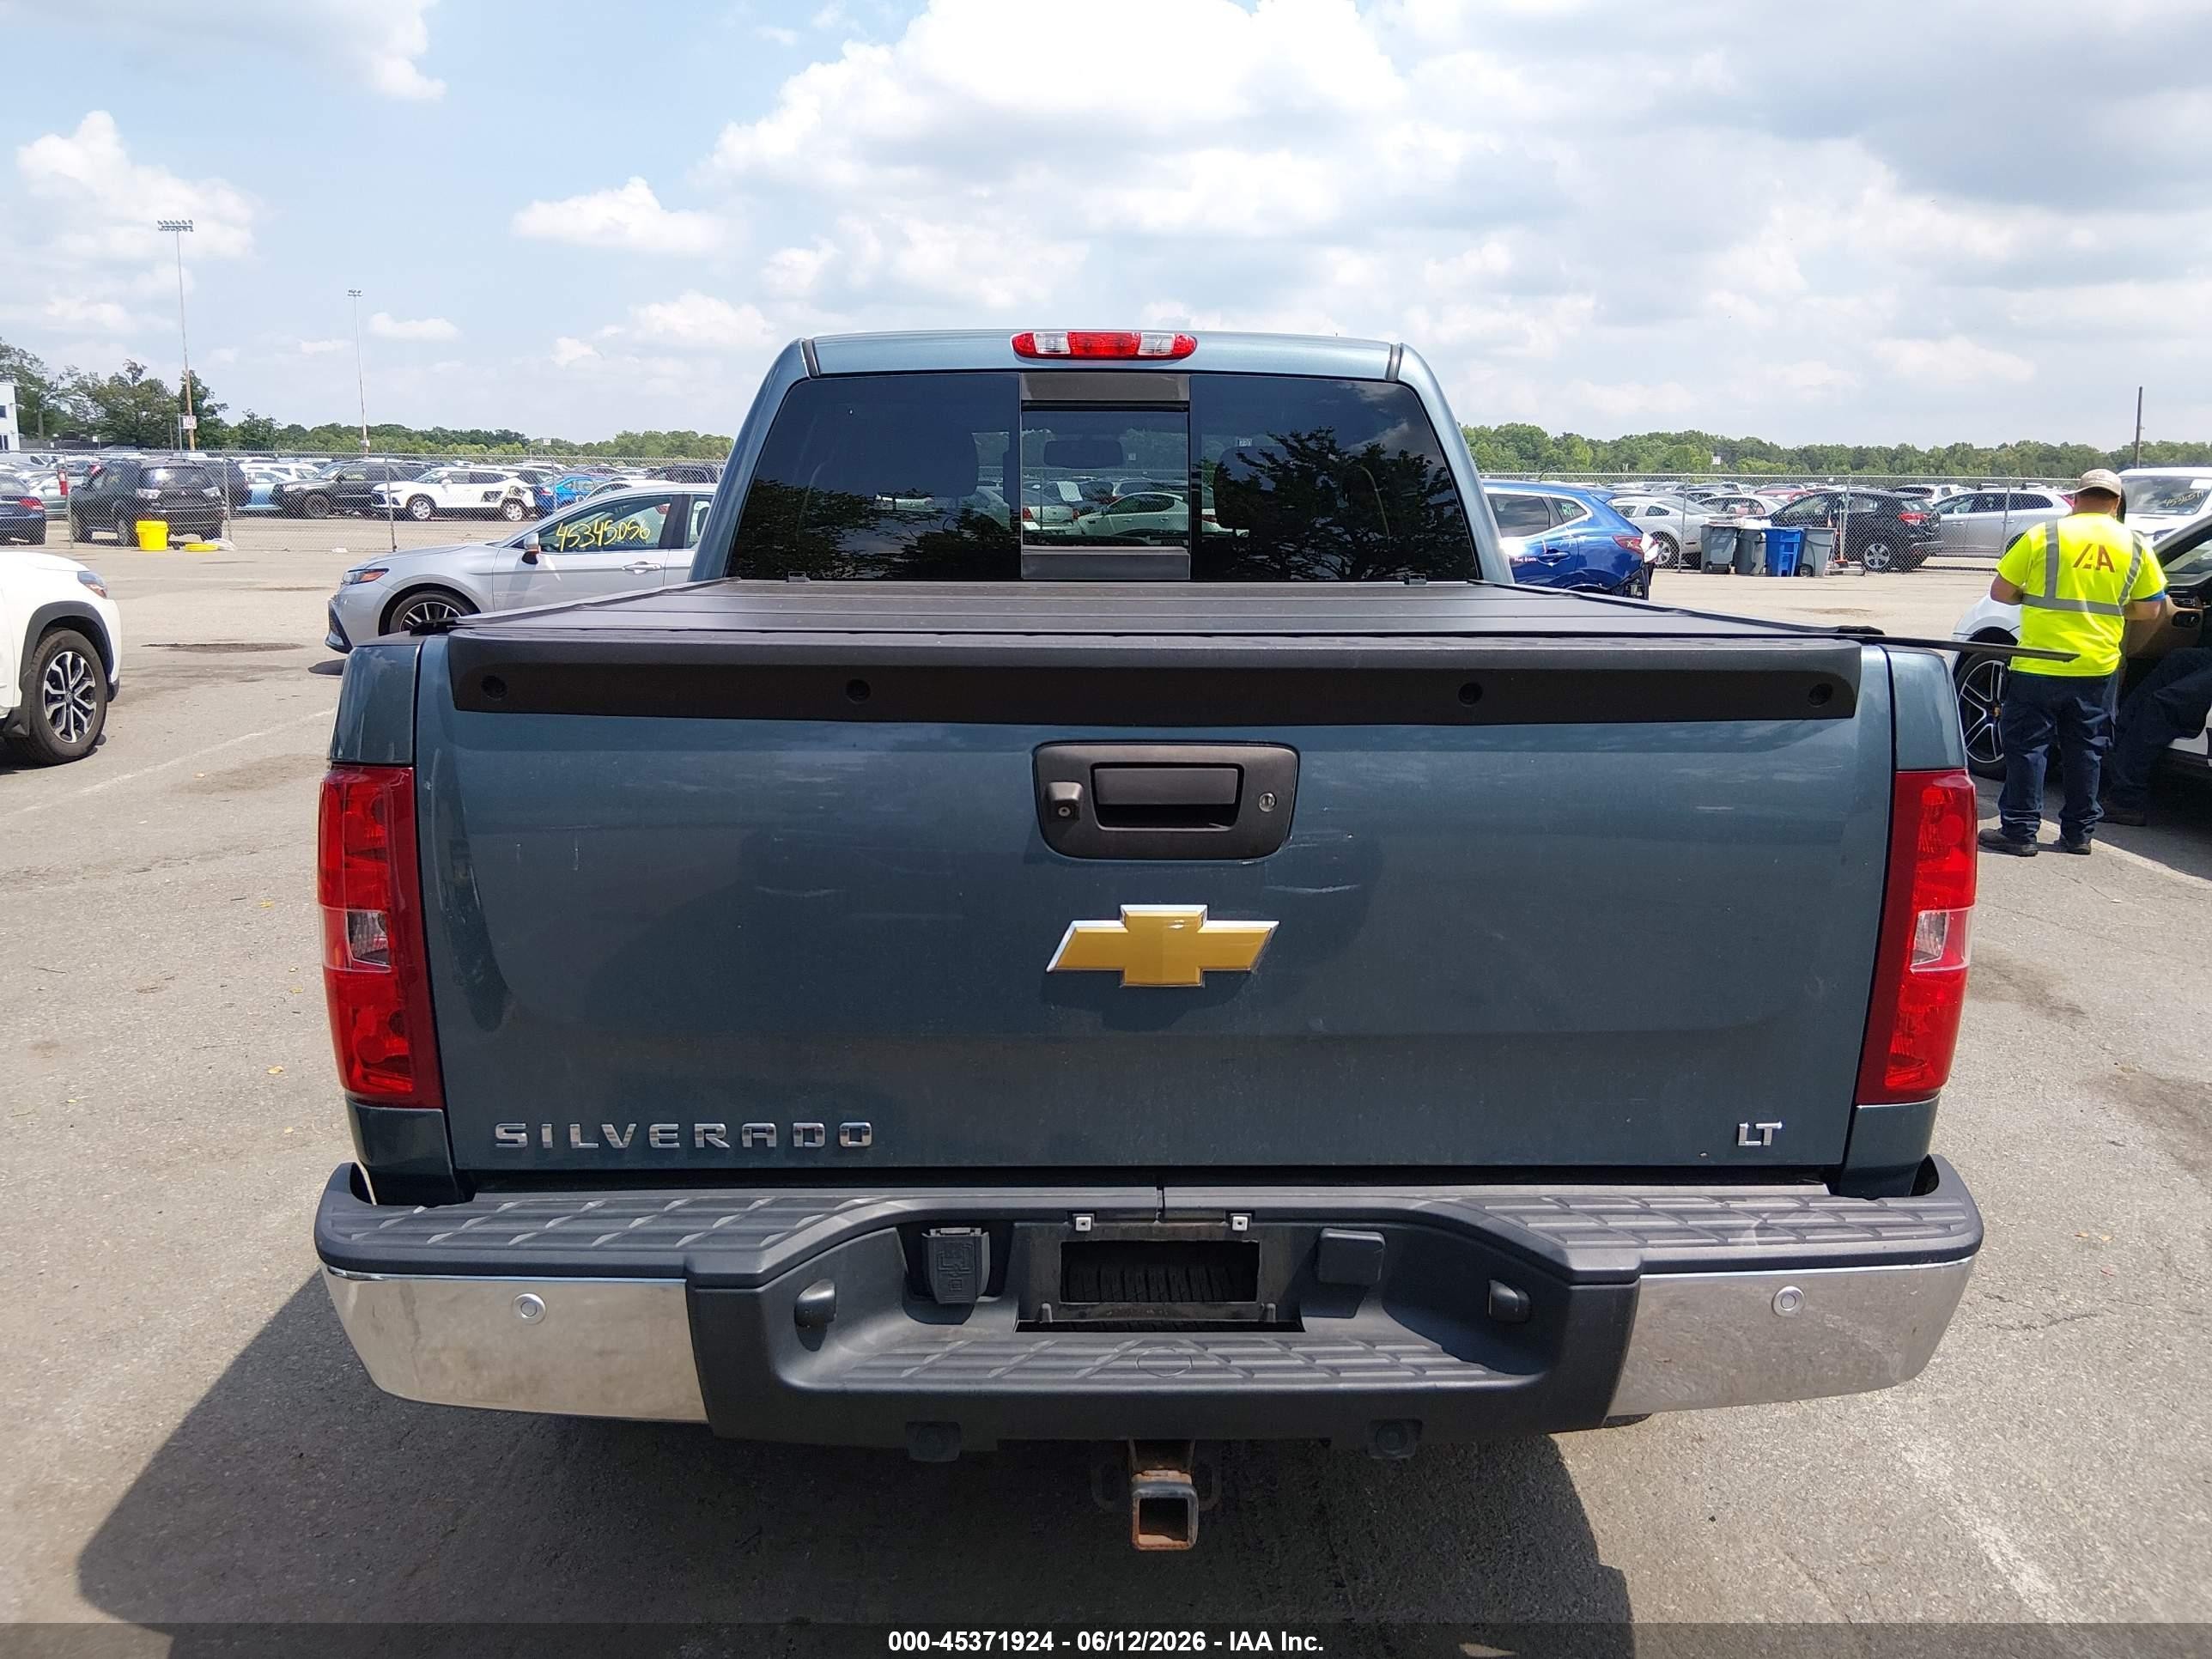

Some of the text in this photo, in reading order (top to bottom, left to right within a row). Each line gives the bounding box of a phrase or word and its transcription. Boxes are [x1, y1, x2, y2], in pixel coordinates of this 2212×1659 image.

[556, 520, 651, 552] 45345056
[495, 1122, 872, 1149] SILVERADO
[1737, 1121, 1783, 1146] LT
